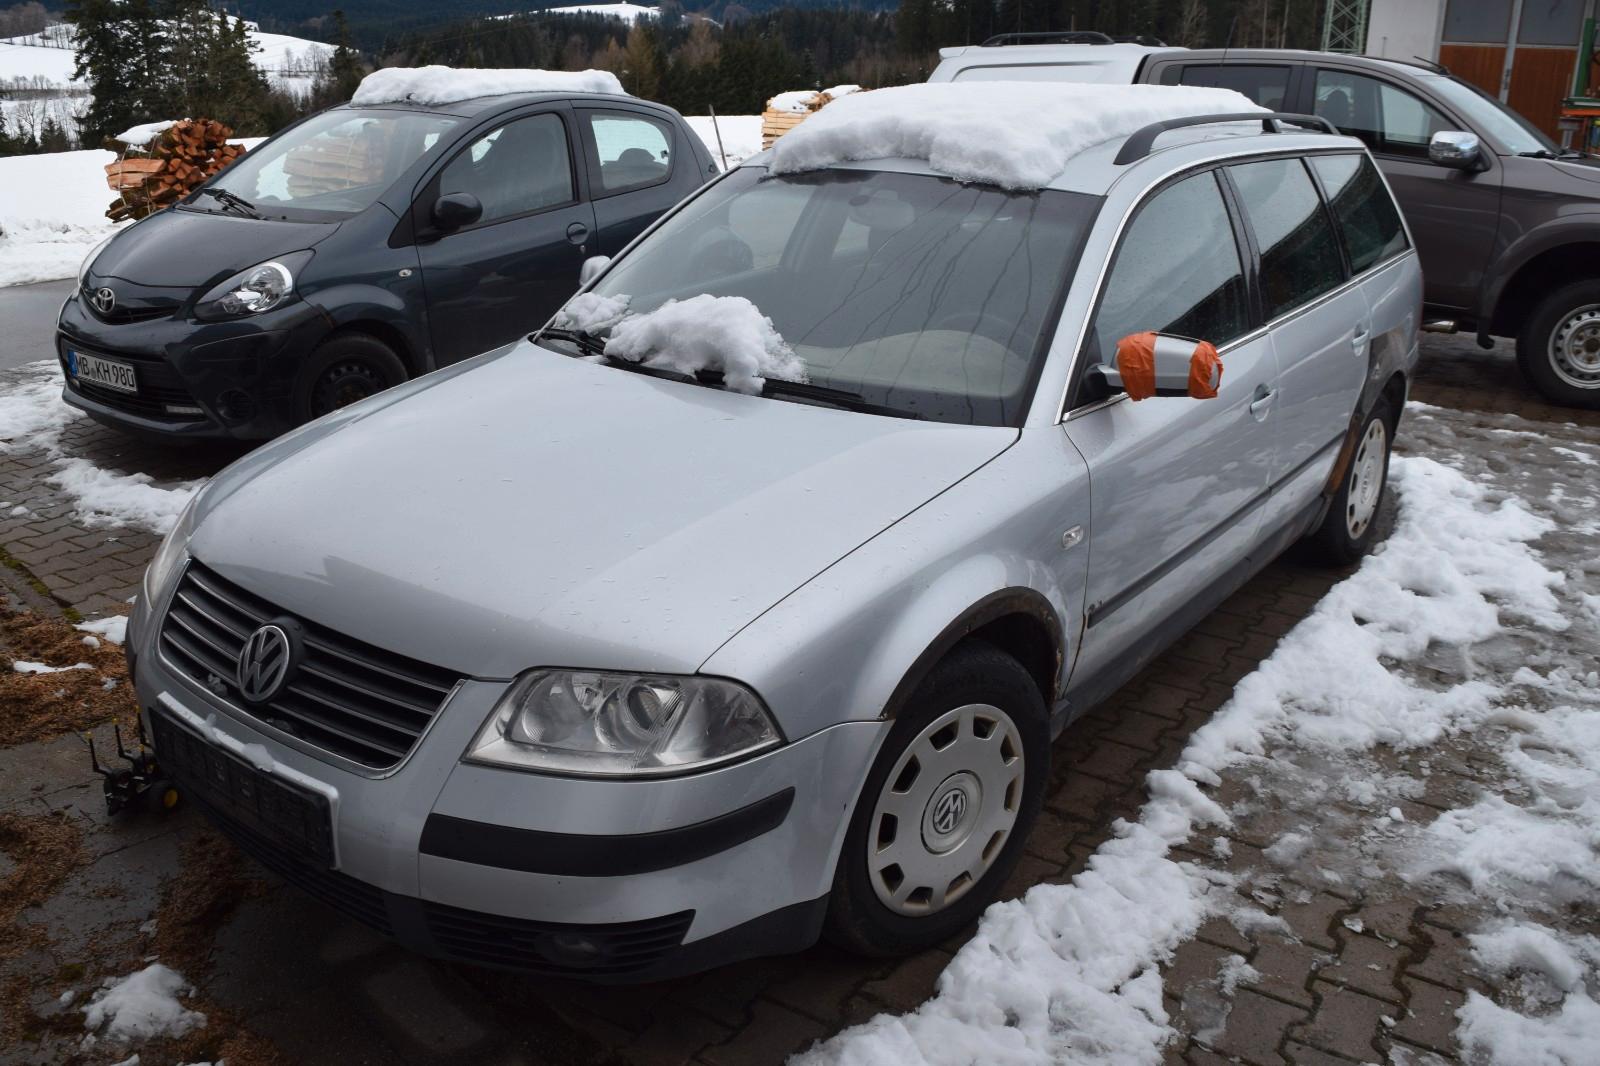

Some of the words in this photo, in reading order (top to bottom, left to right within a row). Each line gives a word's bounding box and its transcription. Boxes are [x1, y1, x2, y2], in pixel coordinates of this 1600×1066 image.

[75, 354, 90, 376] MB
[95, 360, 112, 382] KH
[112, 364, 135, 388] 980
[238, 625, 290, 702] VW
[933, 788, 968, 834] VW
